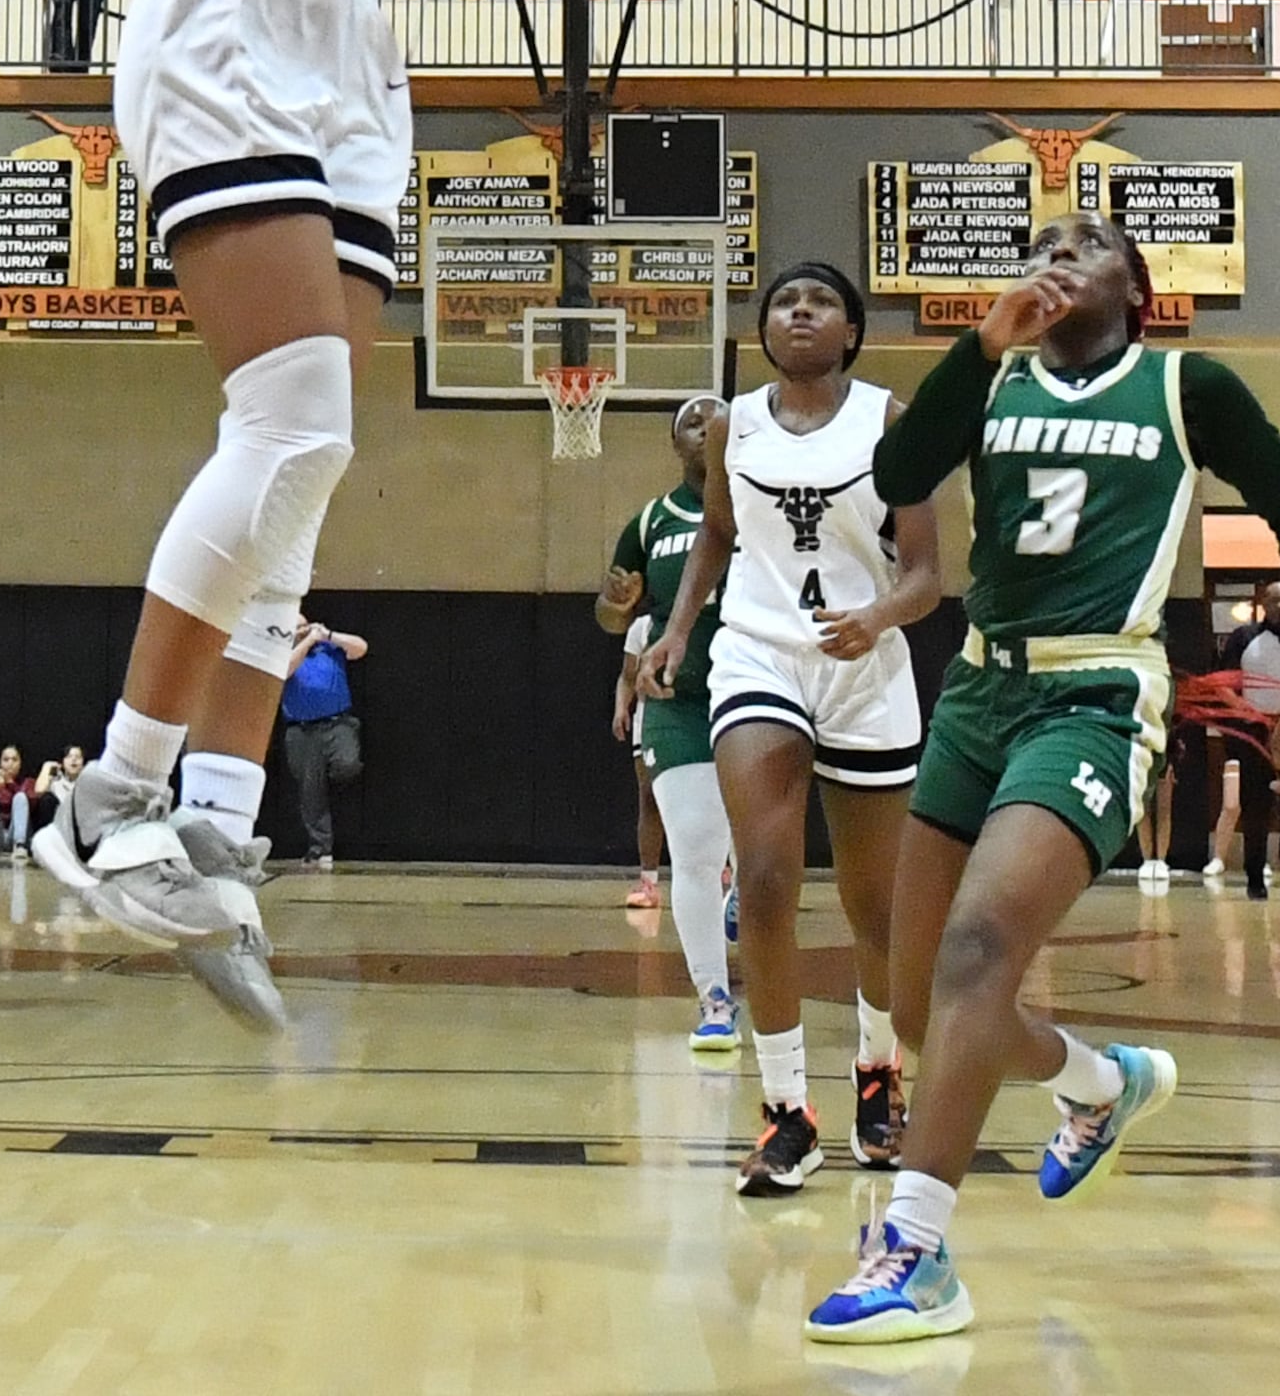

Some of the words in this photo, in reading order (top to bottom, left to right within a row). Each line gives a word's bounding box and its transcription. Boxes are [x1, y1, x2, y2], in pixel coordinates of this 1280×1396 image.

[15, 161, 58, 172] WOOD
[912, 164, 952, 174] HEAVEN
[955, 164, 1026, 174] BOGGS-SMITH
[1081, 165, 1096, 175] 30
[1109, 166, 1161, 177] CRYSTAL
[1163, 166, 1235, 177] HENDERSON
[0, 177, 50, 188] JOHNSON
[119, 179, 135, 190] 20
[446, 178, 484, 190] JOEY
[484, 177, 529, 188] ANAYA
[921, 183, 950, 193] MYA
[953, 181, 1015, 192] NEWSOM
[1081, 180, 1096, 191] 32
[1125, 183, 1156, 194] AIYA
[1160, 183, 1216, 194] DUDLEY
[14, 194, 62, 204] COLON
[120, 194, 135, 206] 21
[434, 194, 498, 206] ANTHONY
[502, 196, 545, 207] BATES
[912, 197, 949, 208] JADA
[953, 197, 1027, 208] PETERSON
[1081, 196, 1096, 207] 42
[1127, 197, 1175, 208] AMAYA
[1178, 197, 1219, 208] MOSS
[119, 210, 135, 221] 22
[489, 215, 550, 226] MASTERS
[910, 215, 962, 226] KAYLEE
[967, 216, 1029, 226] NEWSOM
[1125, 214, 1149, 226] BRI
[1152, 214, 1219, 225] JOHNSON
[15, 225, 57, 235] SMITH
[881, 229, 894, 240] 11
[923, 231, 960, 242] JADA
[963, 231, 1011, 242] GREEN
[1155, 230, 1210, 241] MUNGAI
[119, 242, 134, 253] 25
[881, 247, 895, 258] 21
[920, 247, 976, 258] SYDNEY
[979, 247, 1019, 258] MOSS
[436, 250, 504, 262] BRANDON
[508, 251, 546, 262] MEZA
[592, 253, 616, 263] 220
[643, 252, 684, 263] CHRIS
[119, 258, 134, 269] 31
[880, 262, 895, 274] 23
[909, 263, 958, 274] JAMIAH
[962, 265, 1027, 275] GREGORY
[490, 270, 545, 281] AMSTUTZ
[635, 269, 694, 281] JACKSON
[925, 299, 994, 321] GIRL
[982, 417, 1162, 461] PANTHERS
[1015, 468, 1088, 555] 3
[799, 568, 826, 623] 4
